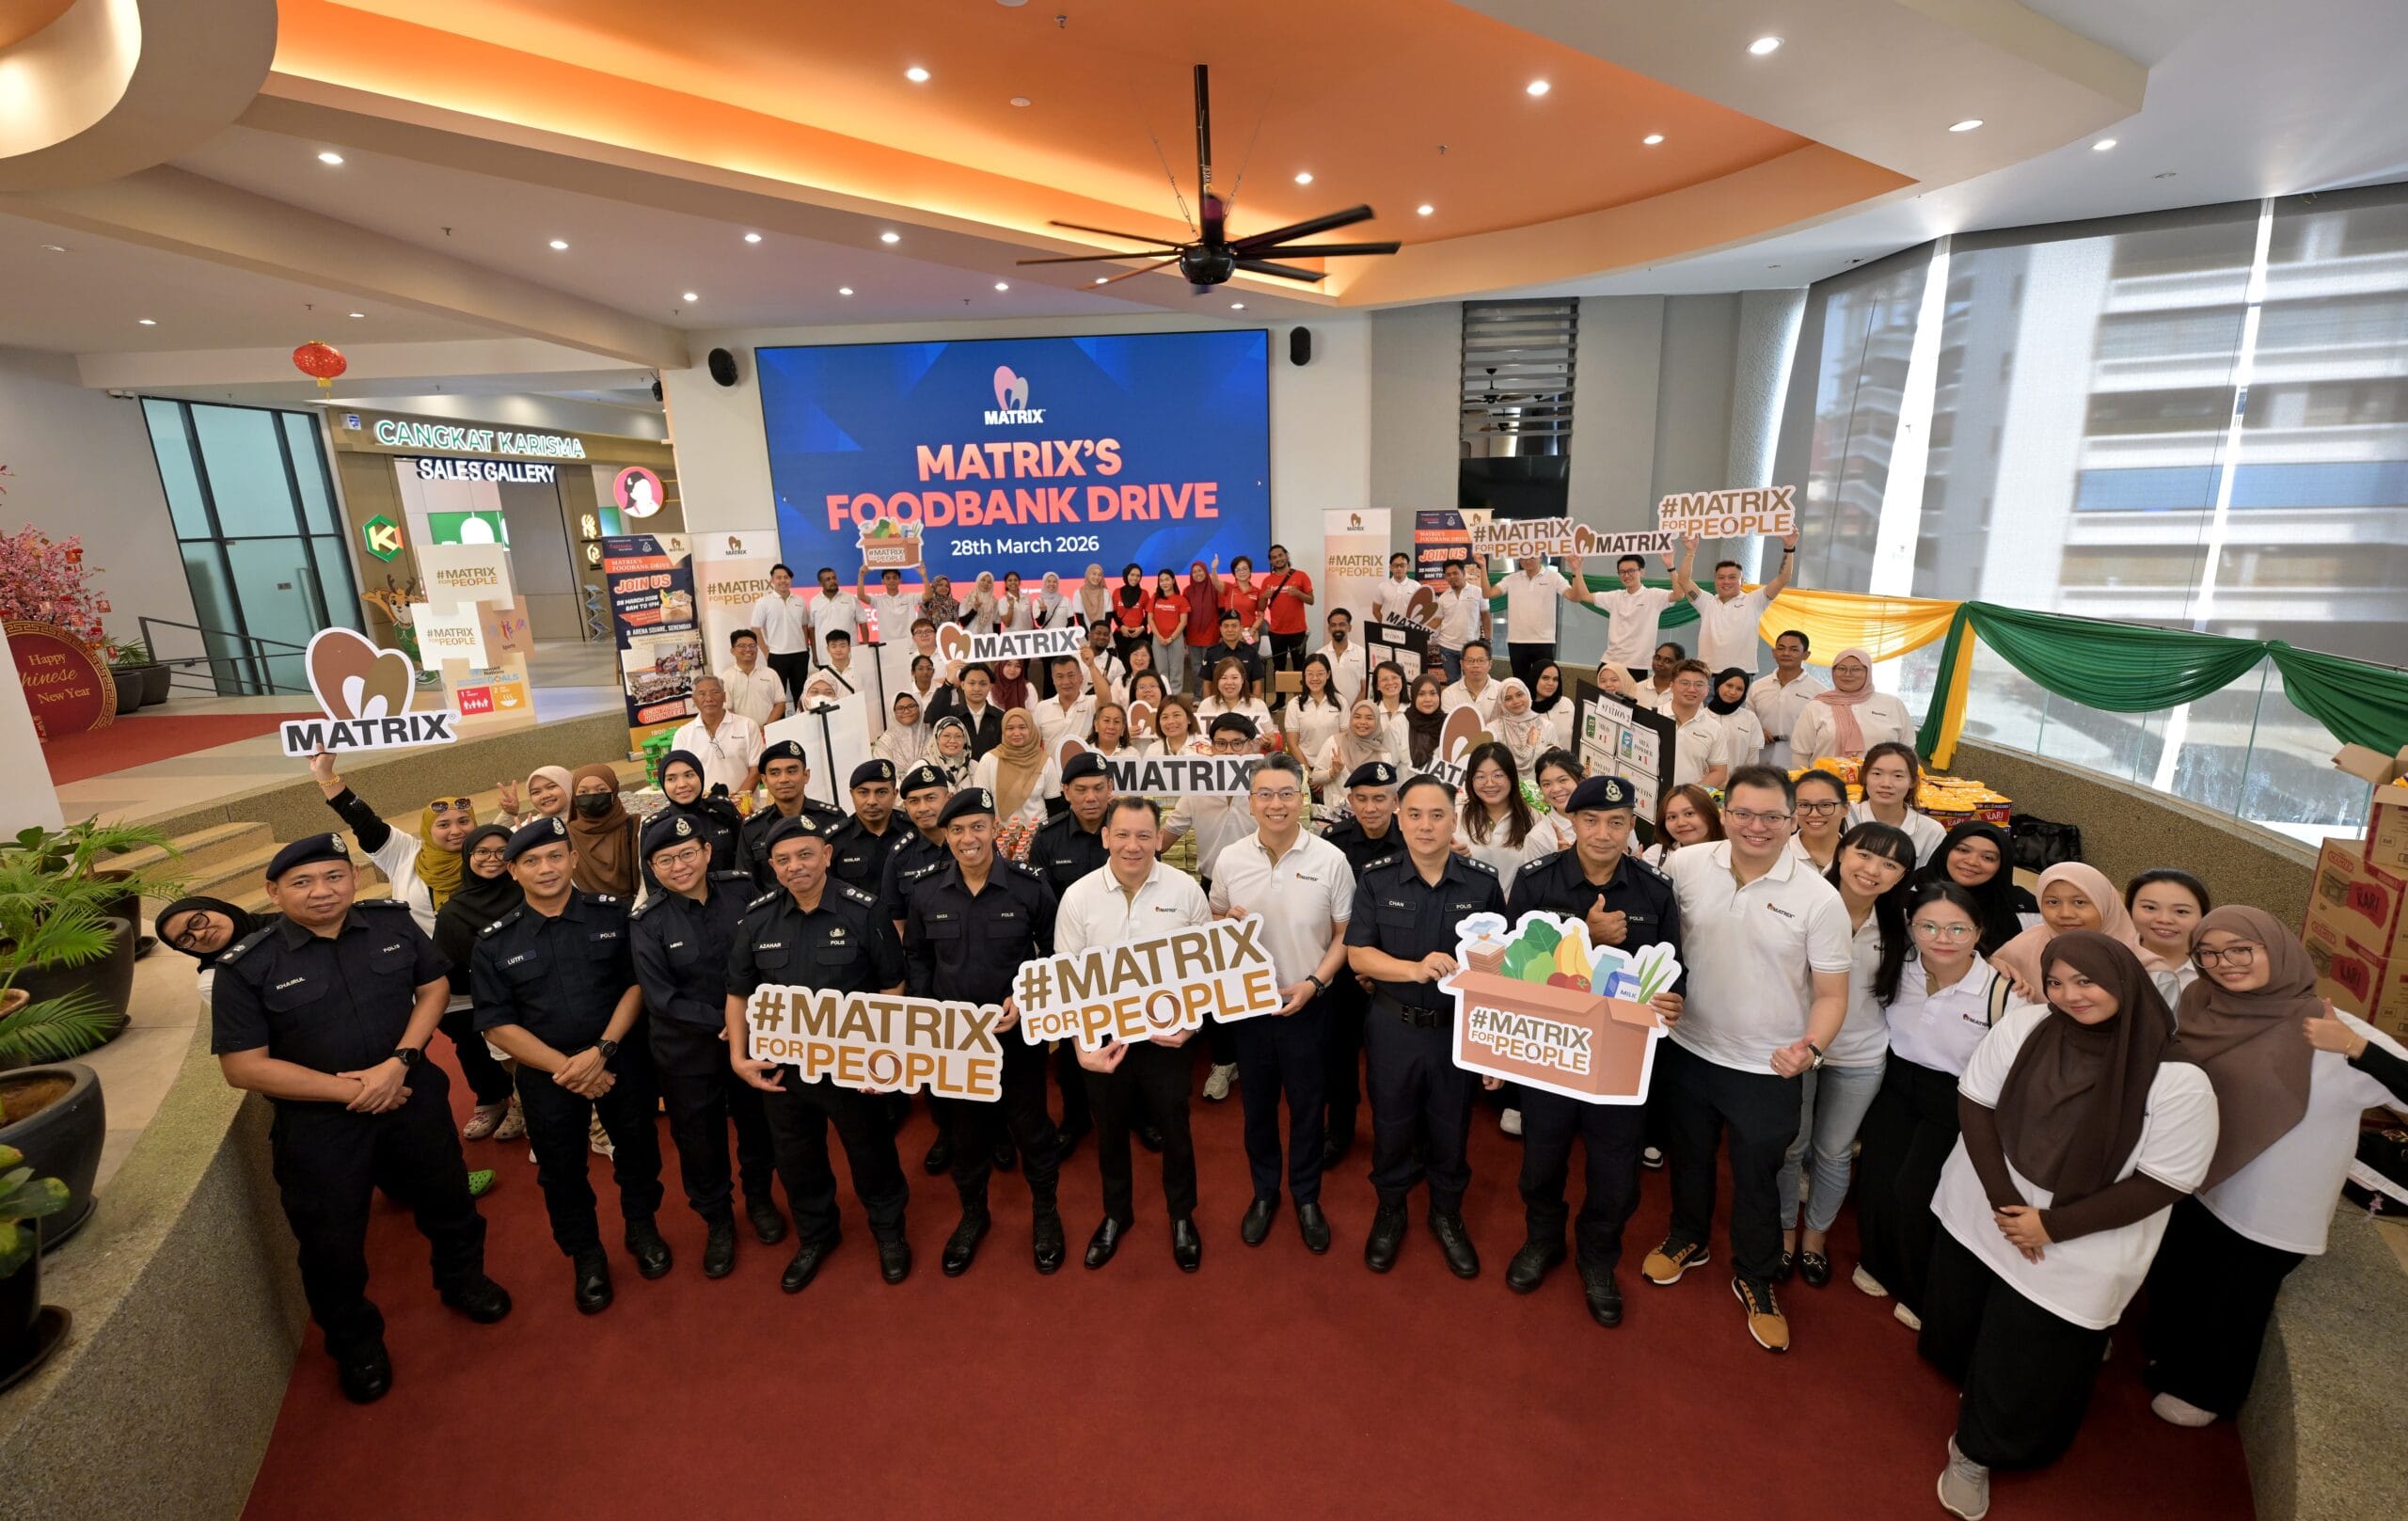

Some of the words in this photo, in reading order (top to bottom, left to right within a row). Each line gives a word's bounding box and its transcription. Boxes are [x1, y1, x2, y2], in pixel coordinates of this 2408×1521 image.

[984, 408, 1044, 425] MATRIX
[376, 420, 493, 452] CANGKAT
[498, 431, 585, 458] KARISMA
[917, 438, 1122, 482] MATRIX’S
[420, 459, 481, 481] SALES
[483, 462, 556, 483] GALLERY
[826, 487, 1081, 531] FOODBANK
[1086, 483, 1219, 521] DRIVE
[1662, 488, 1791, 517] #MATRIX
[1474, 518, 1574, 543] #MATRIX
[1662, 518, 1686, 531] FOR
[1687, 514, 1790, 537] PEOPLE
[951, 539, 992, 557] 28th
[996, 536, 1053, 556] March
[1056, 535, 1100, 552] 2026
[1475, 543, 1495, 553] FOR
[1495, 539, 1572, 559] PEOPLE
[1596, 532, 1671, 554] MATRIX
[1328, 555, 1383, 566] #MATRIX
[1418, 548, 1449, 562] JOIN
[1449, 547, 1467, 560] US
[436, 567, 497, 579] #MATRIX
[1339, 566, 1384, 577] PEOPLE
[452, 577, 498, 587] PEOPLE
[614, 577, 649, 594] JOIN
[650, 574, 672, 588] US
[707, 579, 773, 594] #MATRIX
[723, 592, 772, 605] PEOP
[426, 627, 474, 638] #MATRIX
[439, 636, 477, 646] PEOPLE
[974, 630, 1078, 658] MATRIX
[27, 653, 66, 666] Happy
[22, 669, 77, 688] hinese
[487, 673, 519, 683] GOALS
[38, 692, 64, 704] New
[65, 688, 90, 699] Year
[1601, 704, 1626, 720] STATION
[286, 714, 450, 752] MATRIX
[1109, 760, 1251, 791] MATRIX
[382, 943, 401, 953] POLIS
[507, 955, 524, 965] LUTFI
[1020, 920, 1266, 1011] #MATRIX
[276, 976, 306, 990] KHAIRUL
[1620, 990, 1637, 999] MILK
[1027, 1009, 1080, 1038] FOR
[1081, 969, 1276, 1044] PEOPLE
[752, 990, 997, 1054] #MATRIX
[1471, 1009, 1589, 1052] #MATRIX
[1471, 1030, 1495, 1043] FOR
[1495, 1035, 1588, 1072] PEOPLE
[755, 1037, 804, 1059] FOR
[806, 1042, 995, 1095] PEOPLE
